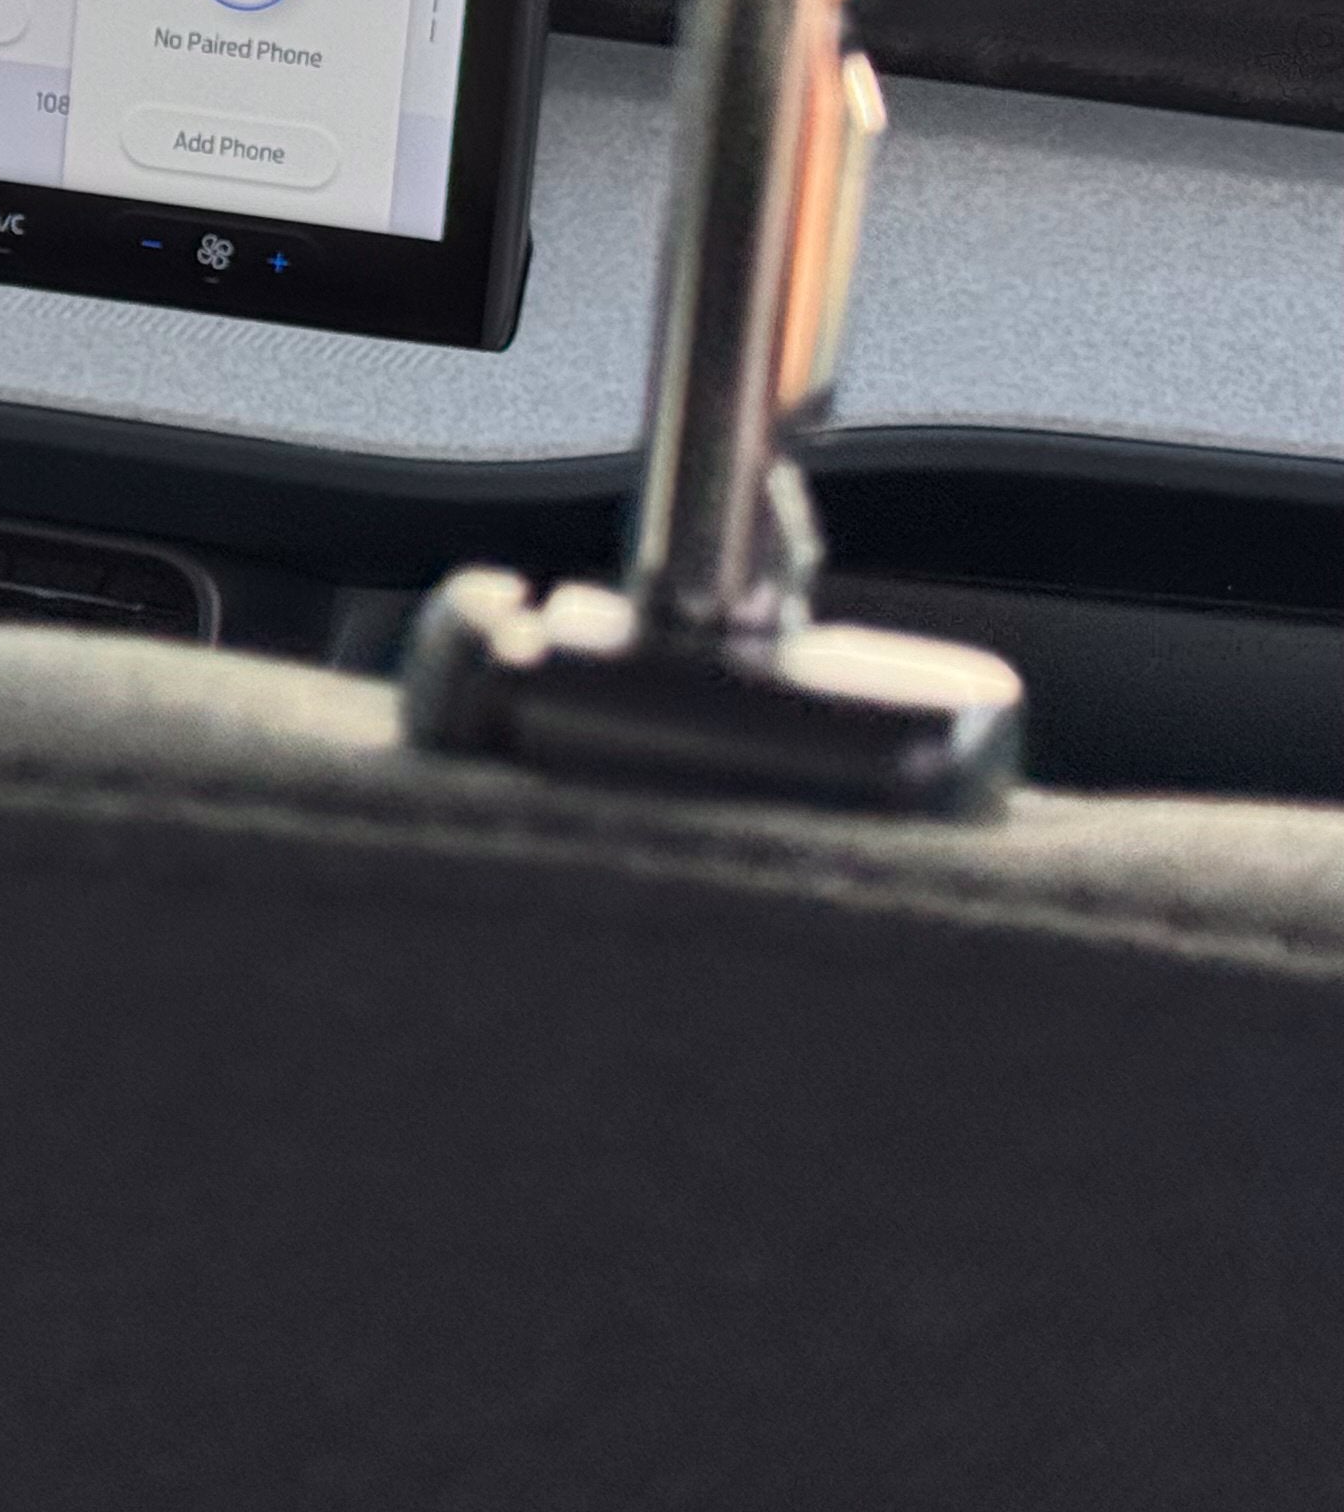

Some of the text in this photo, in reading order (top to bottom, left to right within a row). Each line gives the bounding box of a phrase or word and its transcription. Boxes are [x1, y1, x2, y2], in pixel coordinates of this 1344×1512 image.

[154, 27, 324, 69] No Paired Phone
[173, 130, 286, 164] Add Phone
